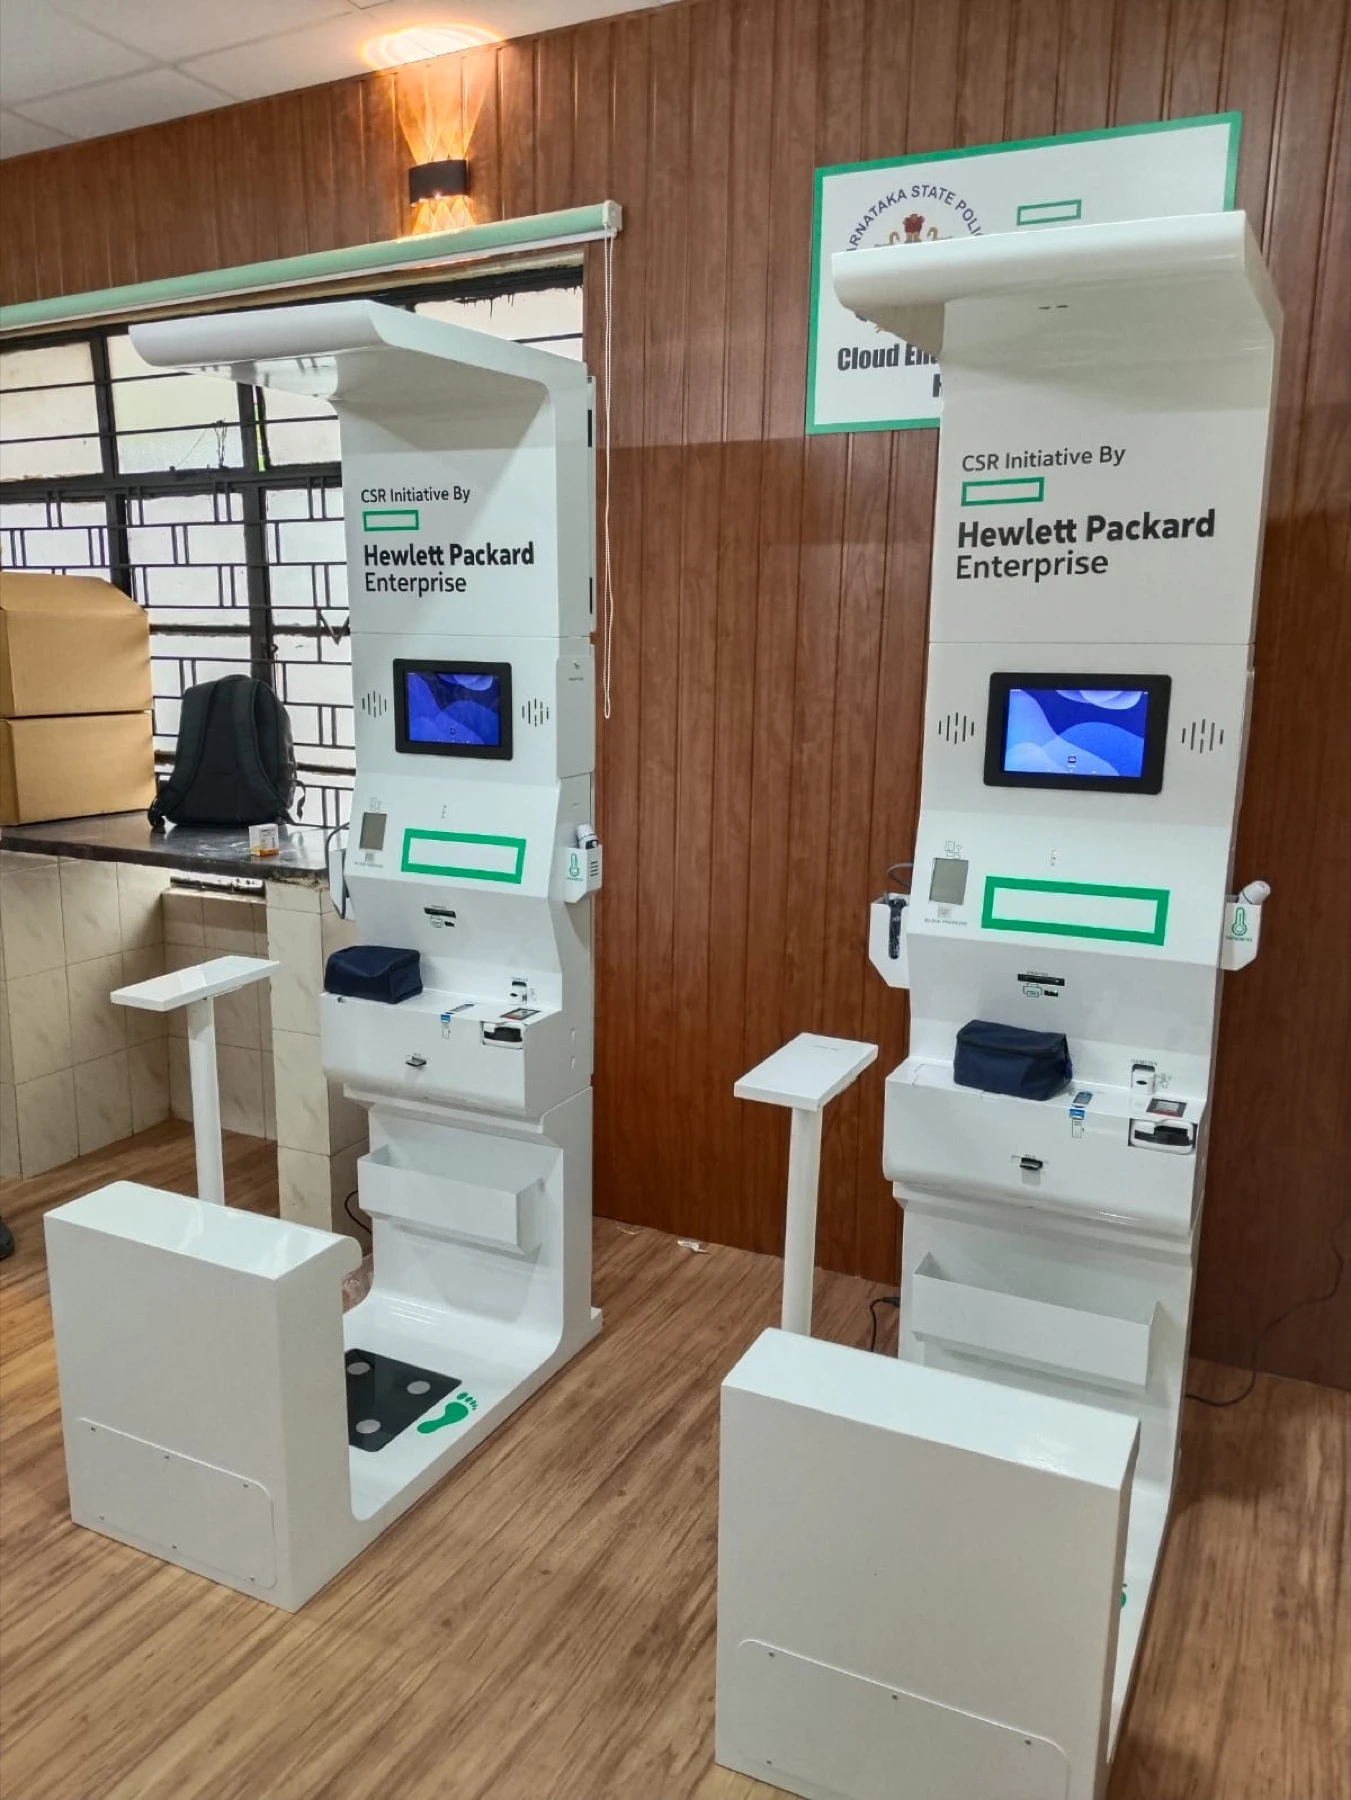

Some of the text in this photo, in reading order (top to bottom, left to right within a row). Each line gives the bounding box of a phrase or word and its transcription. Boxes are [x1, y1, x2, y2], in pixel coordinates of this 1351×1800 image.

[911, 184, 956, 206] STATE
[955, 199, 984, 236] POLI
[838, 343, 900, 371] Cloud
[961, 445, 1126, 472] CSR Initiative By
[360, 485, 471, 504] CSR Initiative By
[958, 508, 1216, 549] Hewlett Packard
[364, 541, 534, 566] Hewlett Packard
[956, 550, 1109, 583] Enterprise
[365, 571, 467, 598] Enterprise
